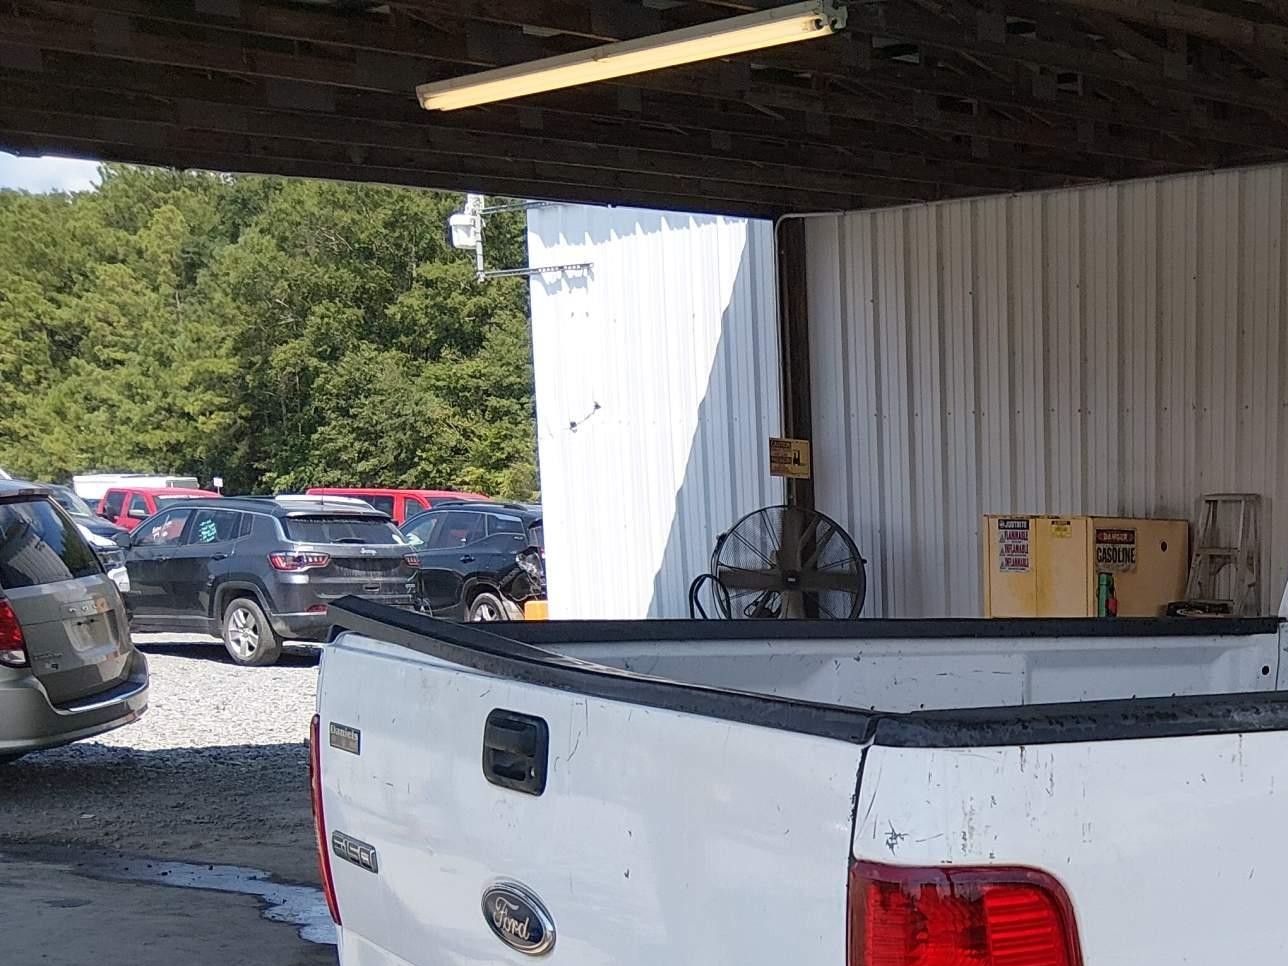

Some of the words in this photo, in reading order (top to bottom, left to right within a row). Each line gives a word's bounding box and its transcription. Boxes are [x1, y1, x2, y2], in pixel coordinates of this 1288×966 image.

[1103, 532, 1128, 540] DANGER
[1096, 547, 1136, 563] GASOLINE
[330, 724, 359, 740] Daniels
[493, 896, 530, 940] Ford
